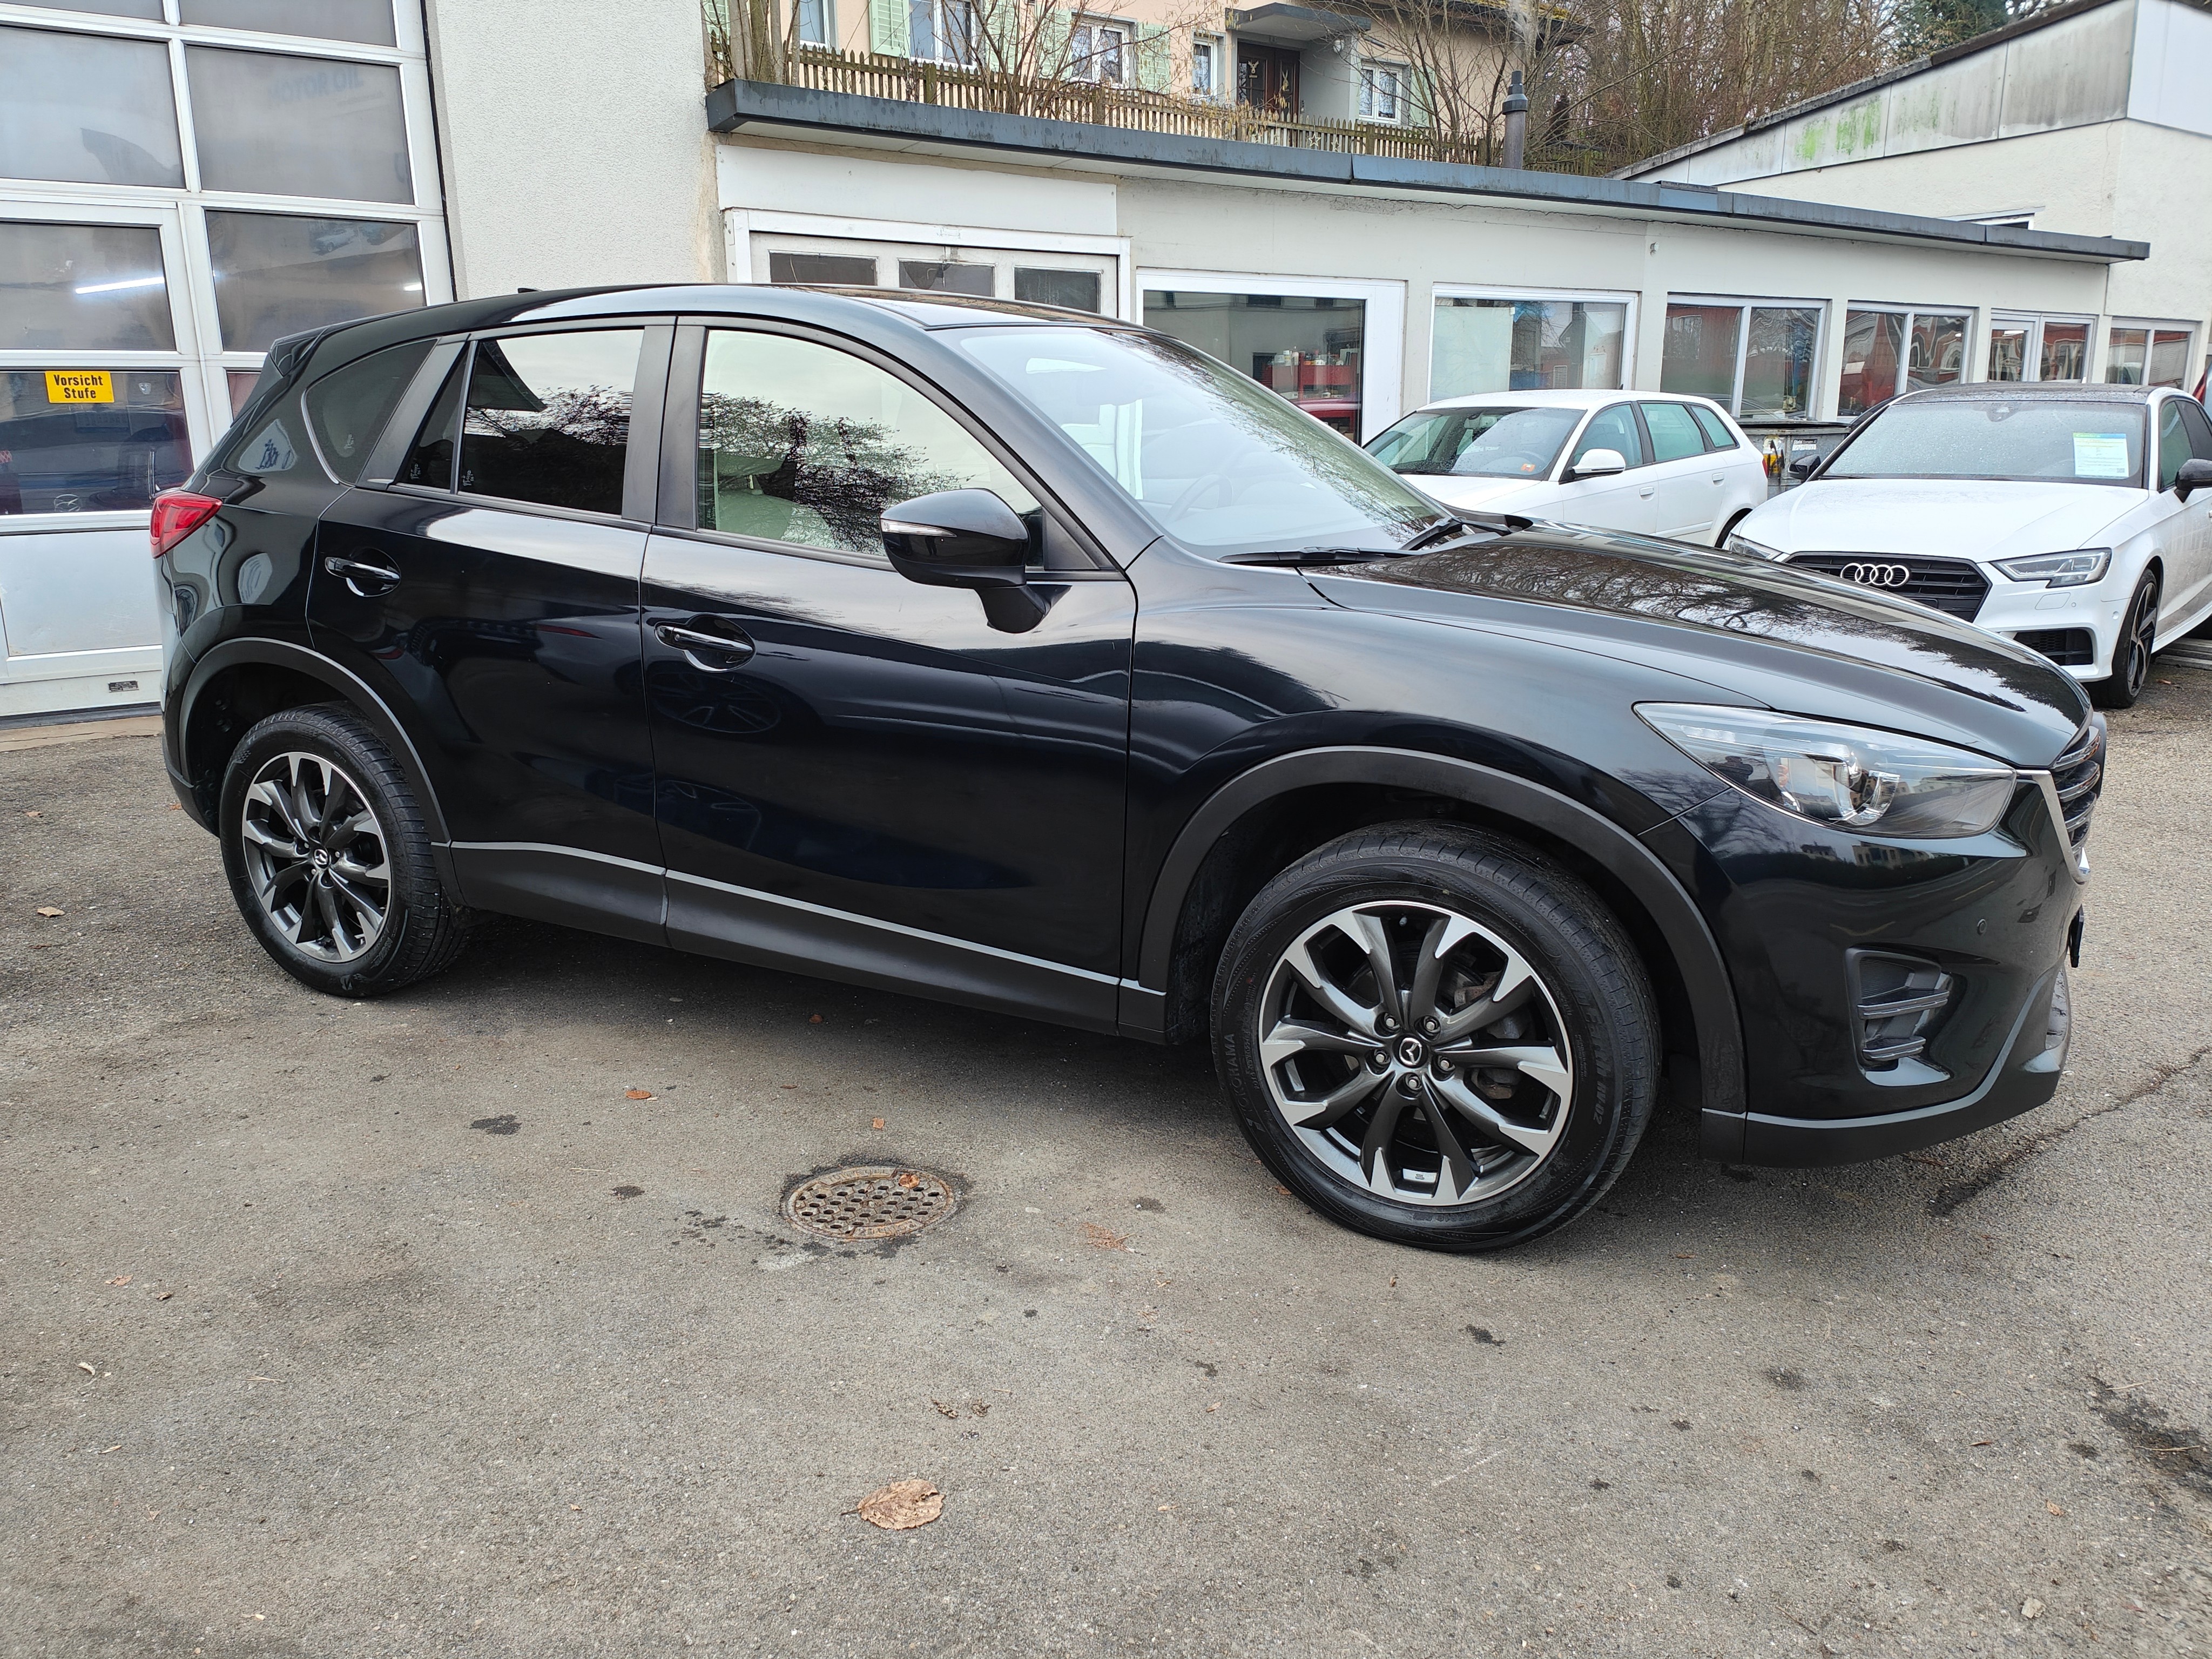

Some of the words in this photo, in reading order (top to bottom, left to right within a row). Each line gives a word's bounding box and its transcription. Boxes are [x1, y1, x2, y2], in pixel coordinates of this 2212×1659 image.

[333, 66, 365, 91] OIL
[53, 374, 103, 386] Vorsicht
[64, 387, 97, 399] Stufe
[1223, 1034, 1252, 1114] YOKOHAMA
[1593, 1081, 1607, 1125] RV-02
